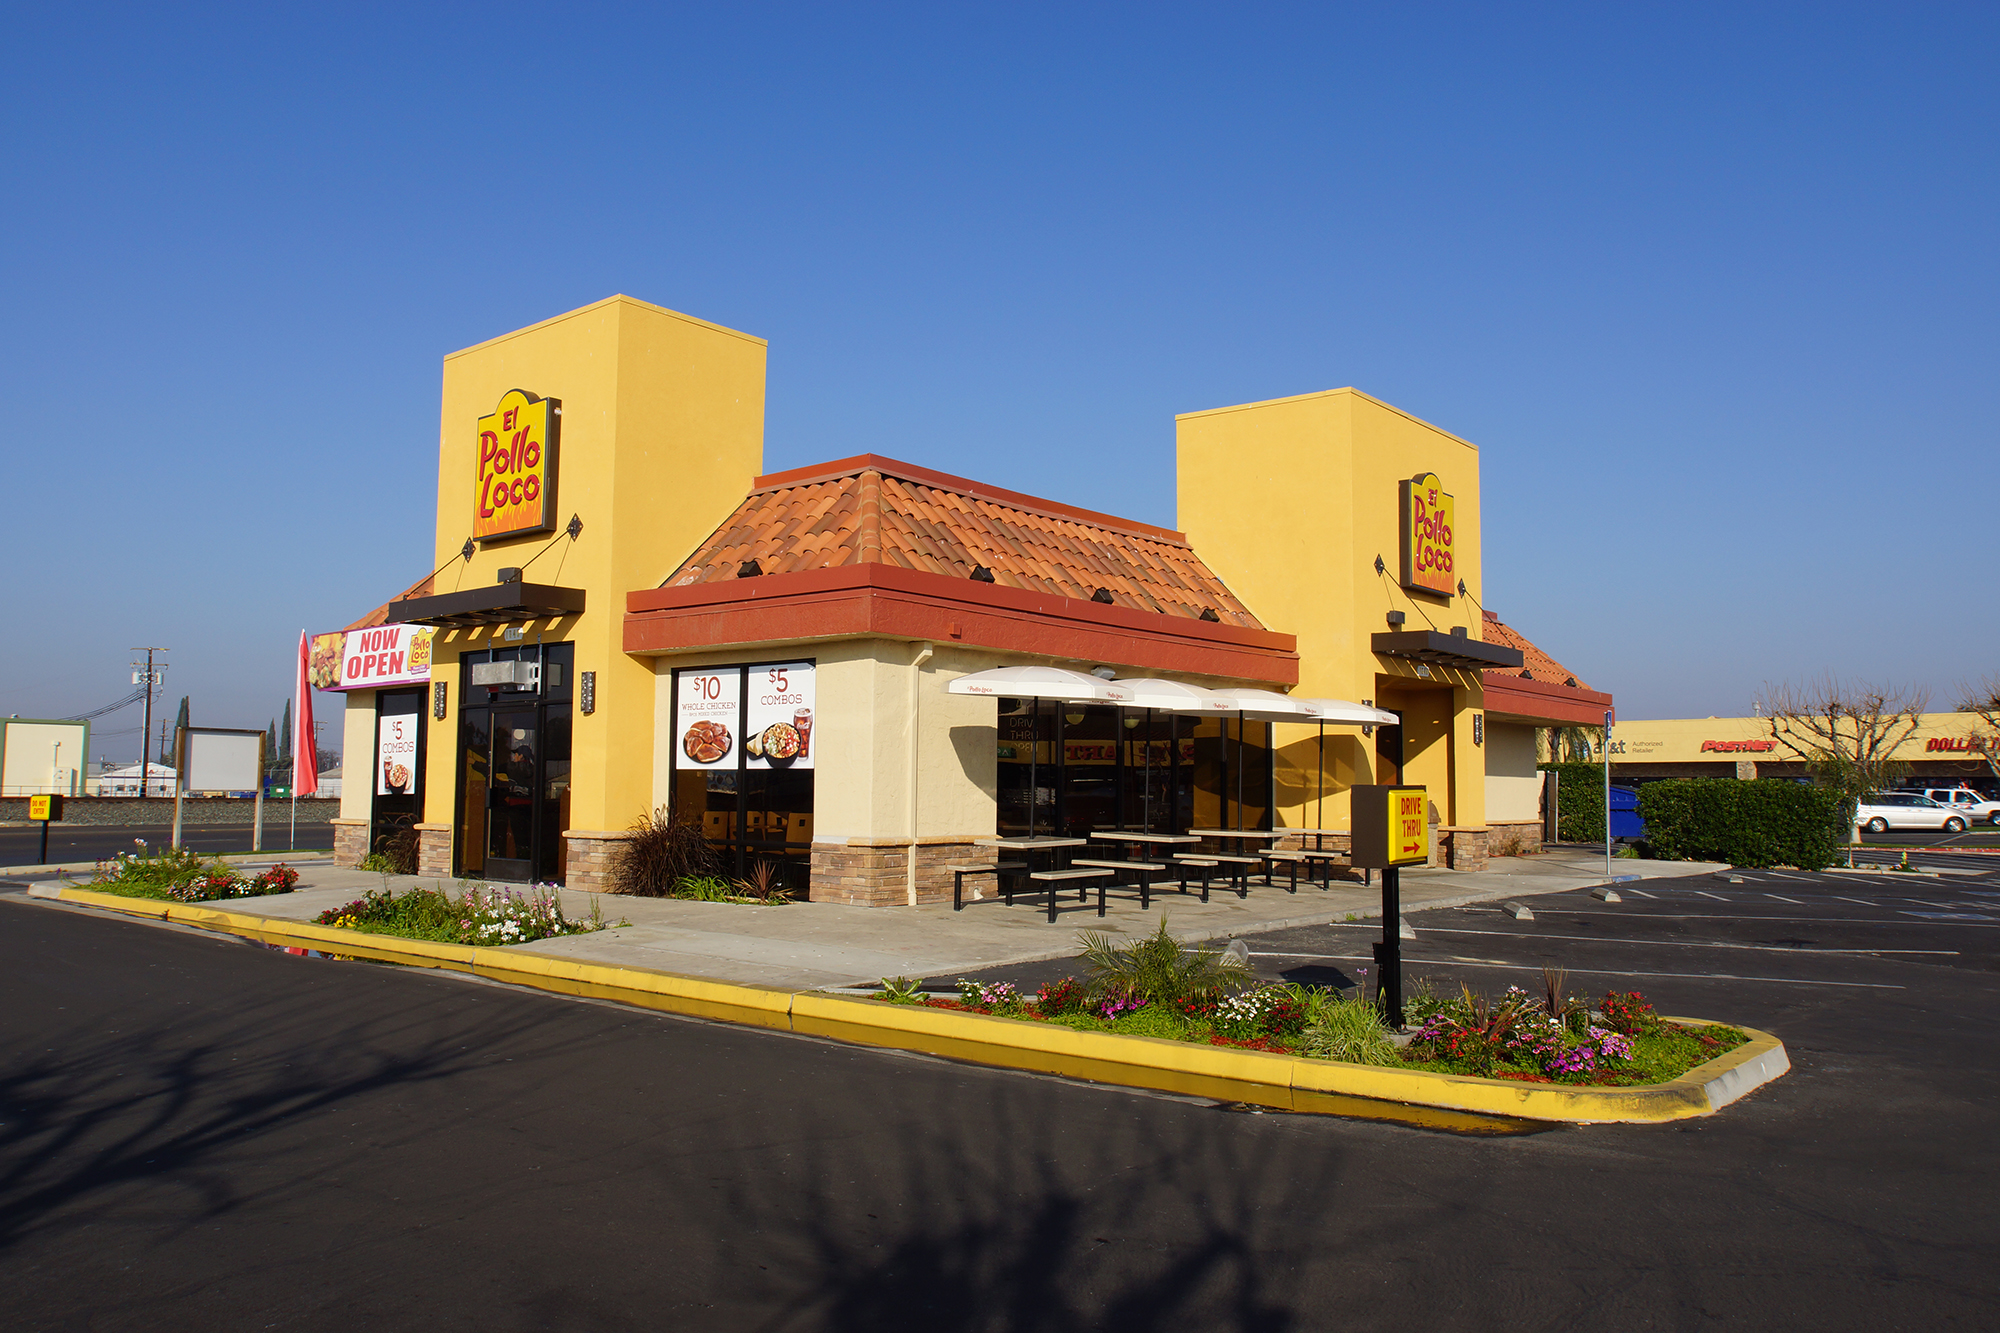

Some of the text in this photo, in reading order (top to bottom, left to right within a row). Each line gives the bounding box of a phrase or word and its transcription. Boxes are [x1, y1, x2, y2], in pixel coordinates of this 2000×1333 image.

[503, 406, 519, 431] El
[479, 425, 541, 481] Pollo
[481, 472, 540, 518] Loco
[1428, 488, 1438, 507] El
[1414, 494, 1452, 546] Pollo
[1416, 533, 1453, 572] Loco
[360, 628, 401, 653] NOW
[412, 637, 430, 652] Pollo
[347, 651, 404, 679] OPEN
[411, 650, 429, 663] Loco
[693, 676, 721, 700] $10
[769, 668, 788, 693] $5
[682, 702, 736, 711] WHOLE CHICKEN
[761, 694, 803, 706] COMBOS
[391, 720, 403, 740] $5
[1009, 717, 1034, 728] DRIV
[382, 741, 415, 754] COMBOS
[1593, 739, 1626, 754] a&t
[1401, 797, 1421, 815] DRIVE
[1402, 819, 1421, 837] THRU
